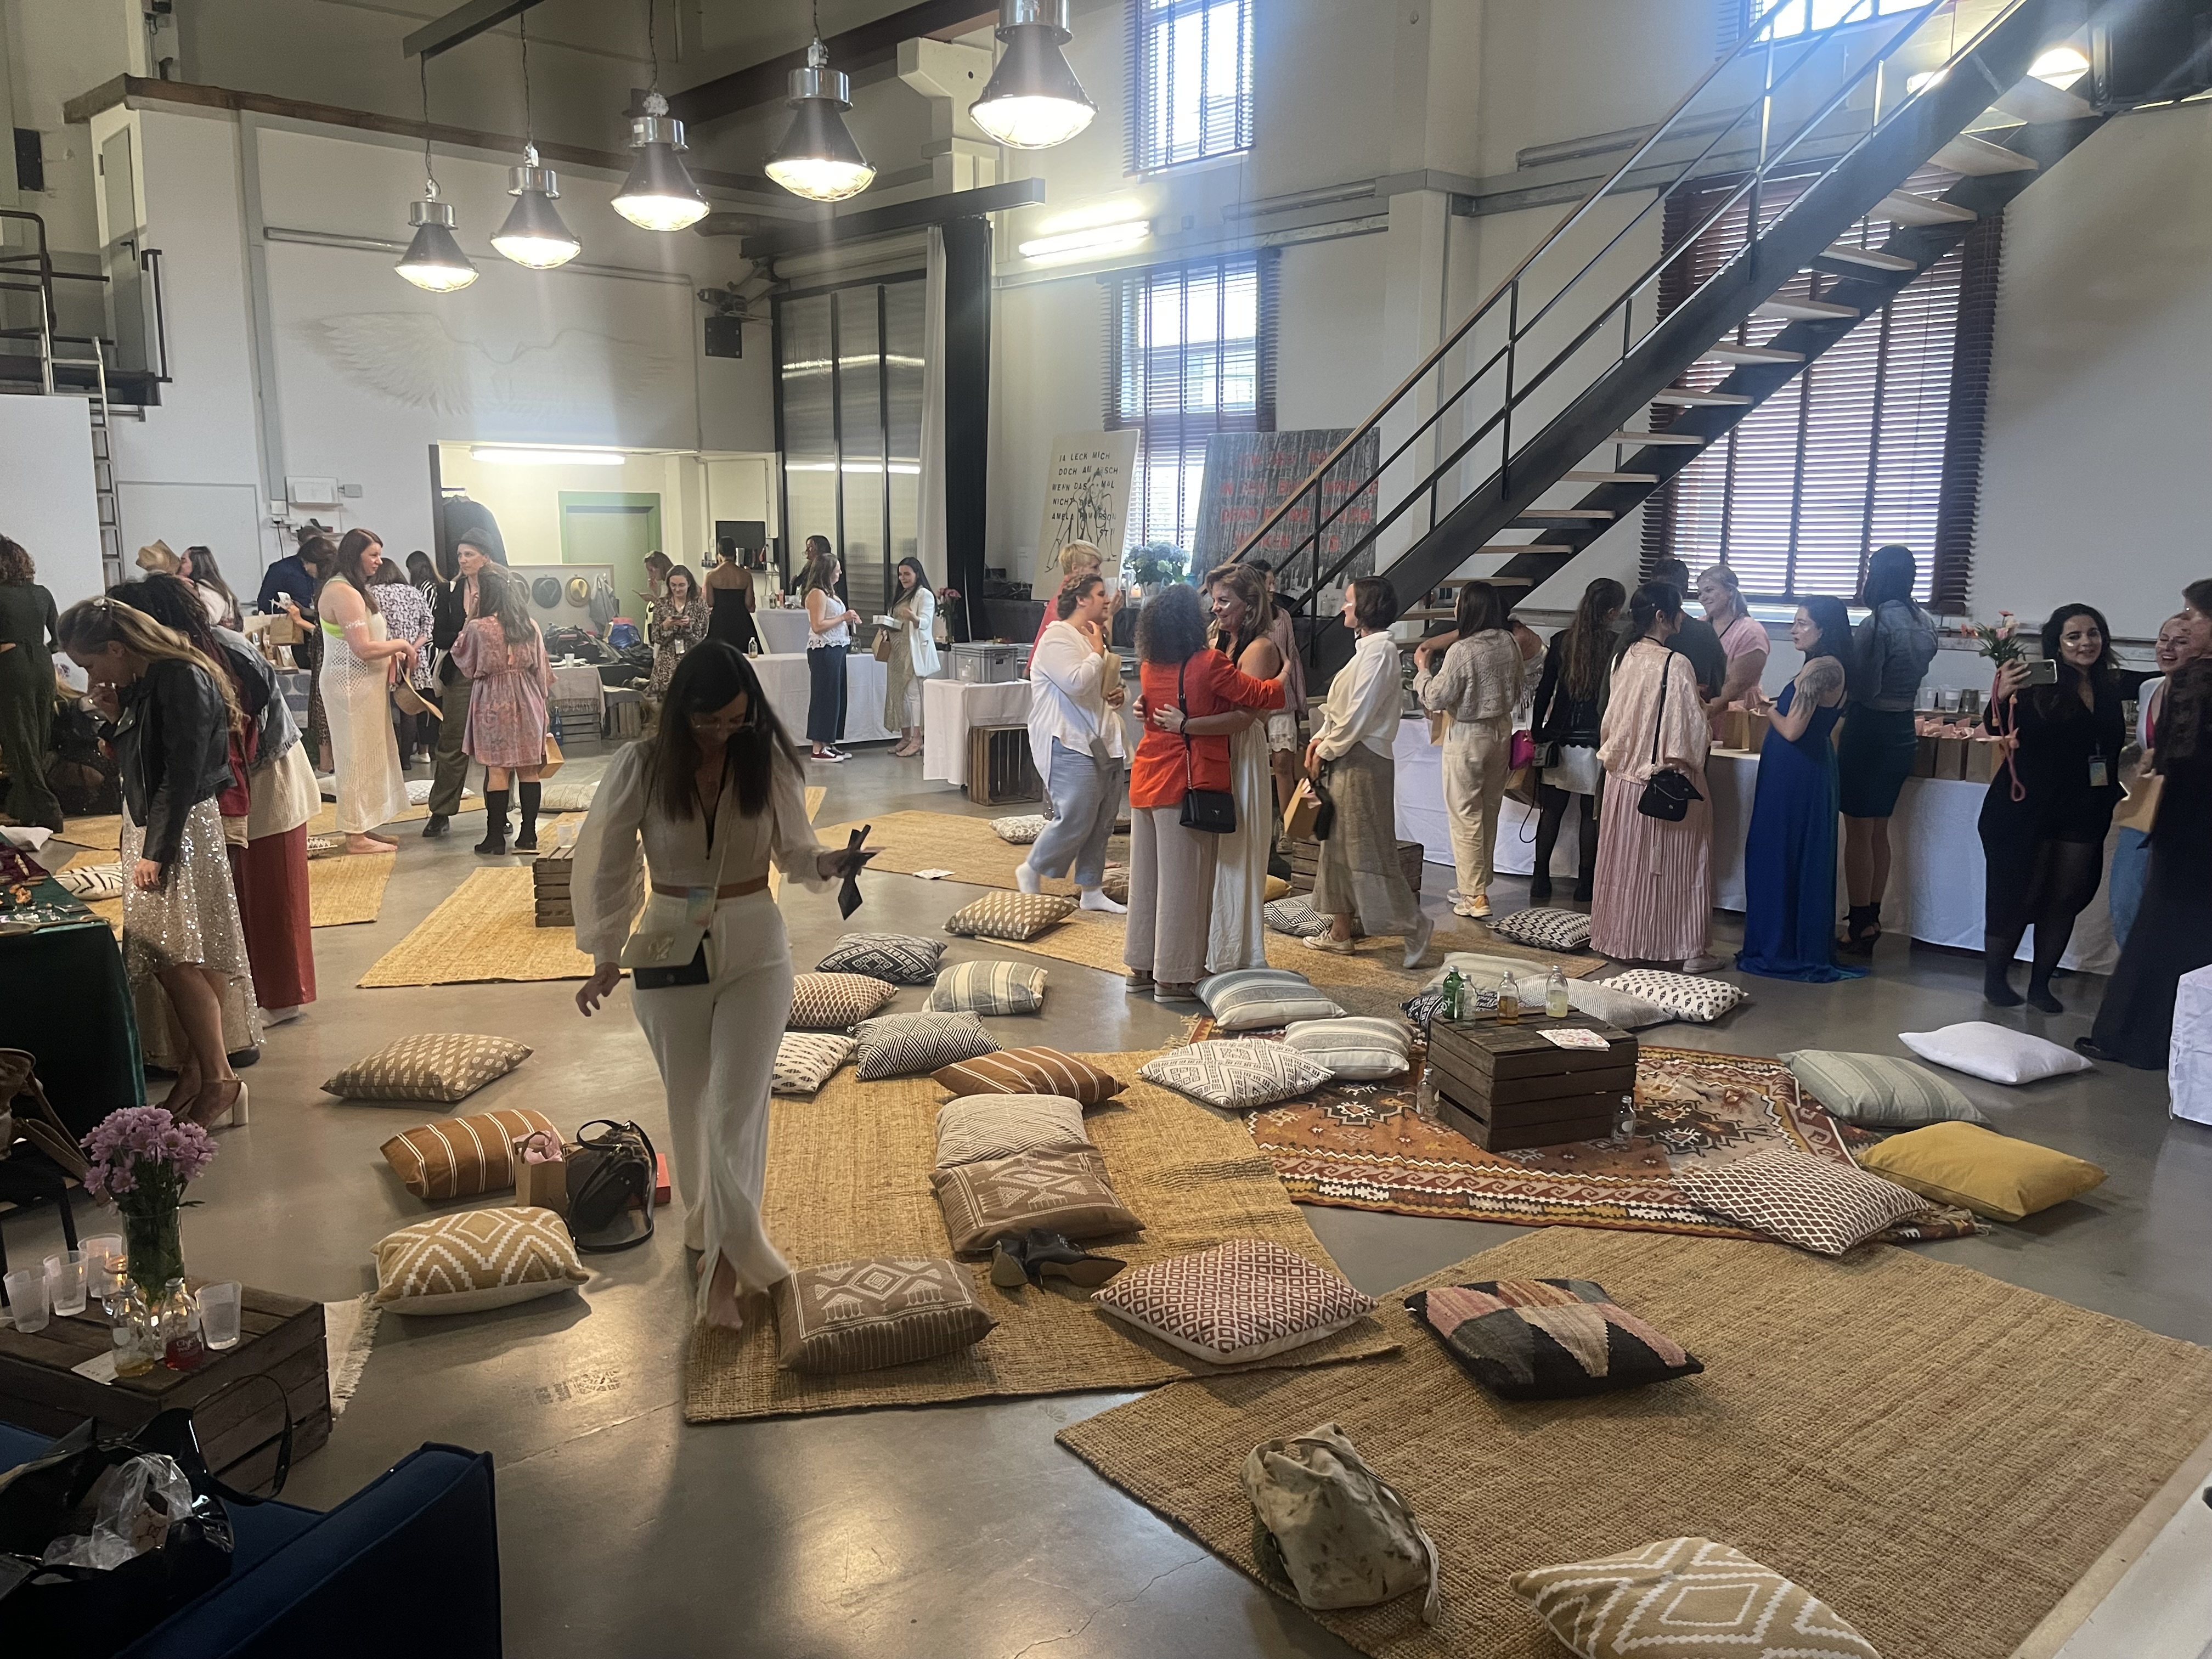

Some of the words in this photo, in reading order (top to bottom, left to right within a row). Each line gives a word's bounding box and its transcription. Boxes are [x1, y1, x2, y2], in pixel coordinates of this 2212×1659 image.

[1070, 453, 1088, 461] LECK
[1092, 451, 1110, 460] MICH
[1074, 482, 1087, 490] DAS
[1101, 480, 1114, 489] MAL
